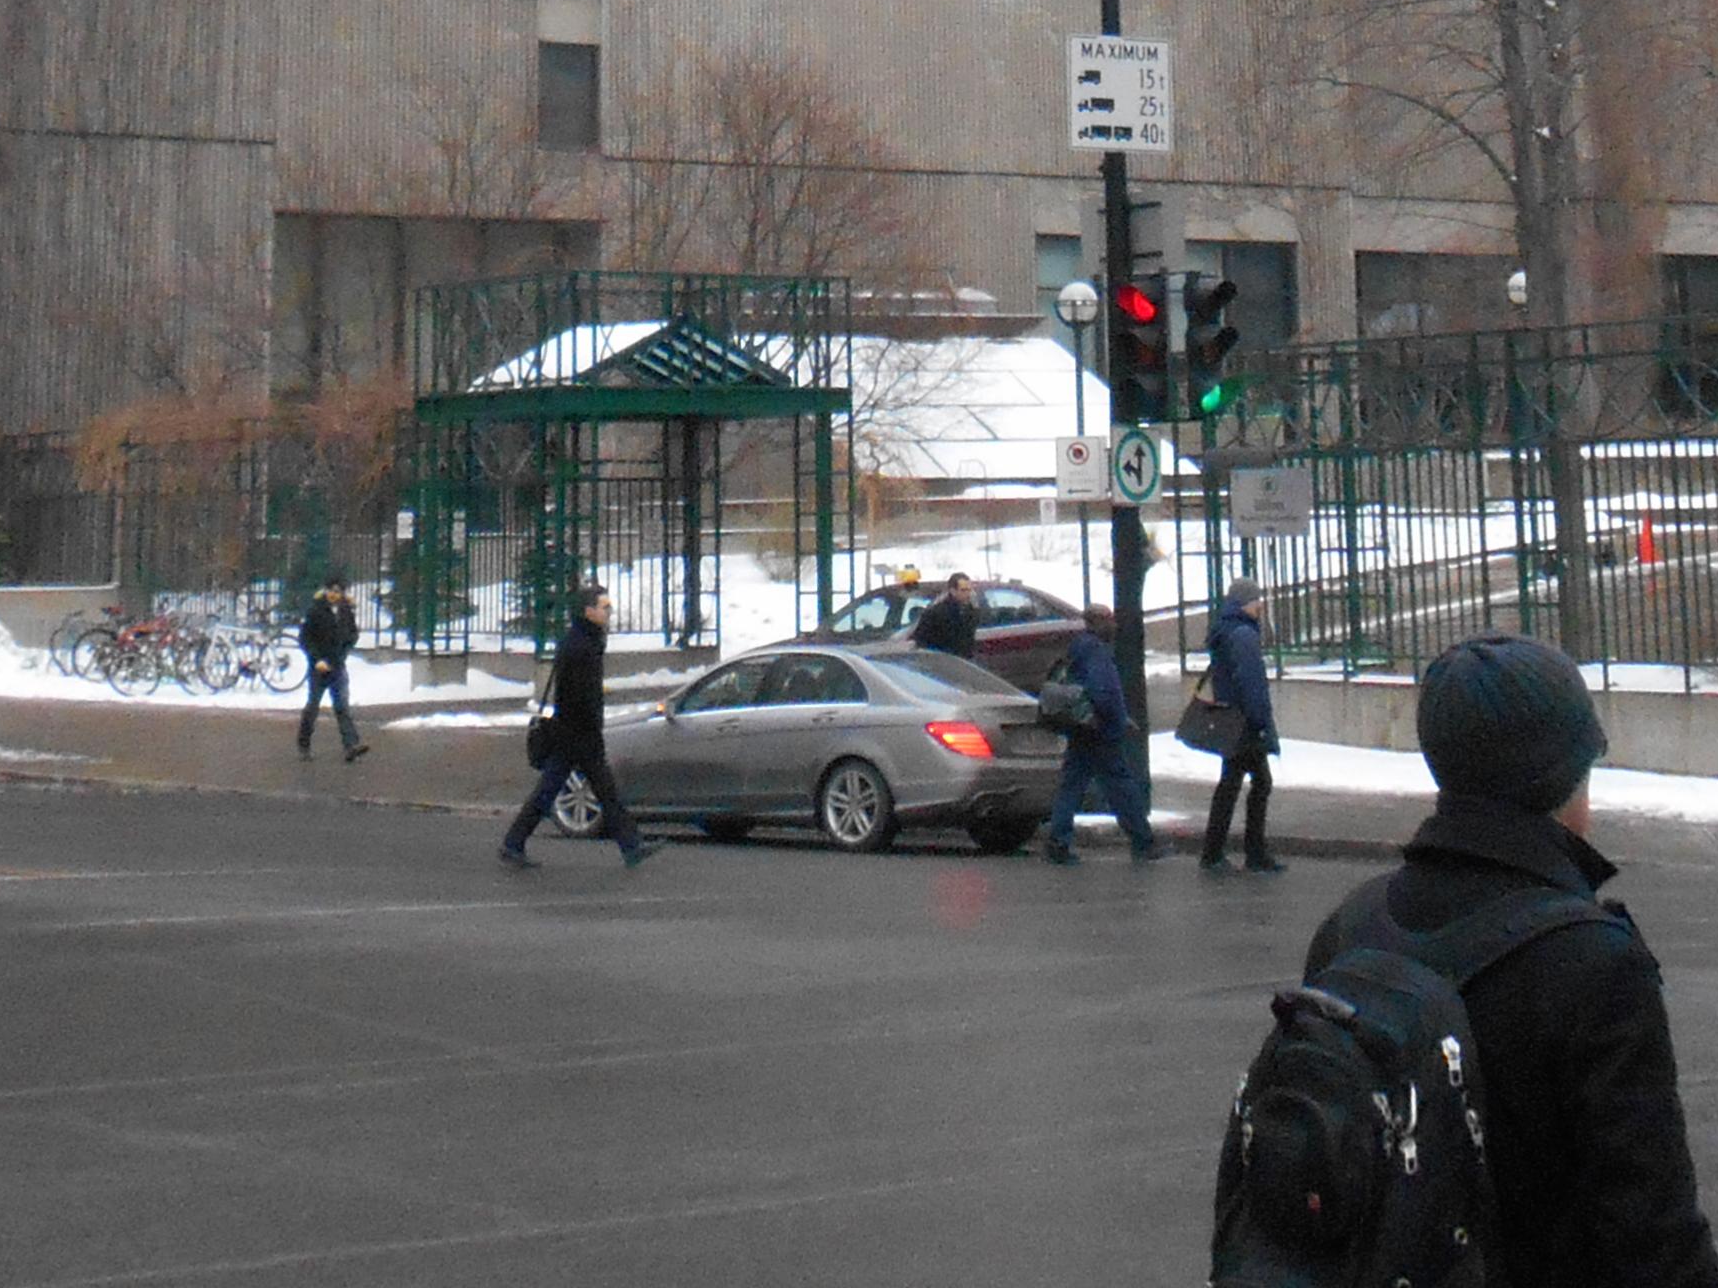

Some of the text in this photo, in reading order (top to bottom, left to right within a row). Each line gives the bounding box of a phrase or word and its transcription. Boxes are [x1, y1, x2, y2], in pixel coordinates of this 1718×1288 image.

[1080, 42, 1159, 61] MAXIMUM
[1139, 68, 1156, 90] 15
[1139, 96, 1157, 117] 25
[1139, 123, 1159, 144] 40
